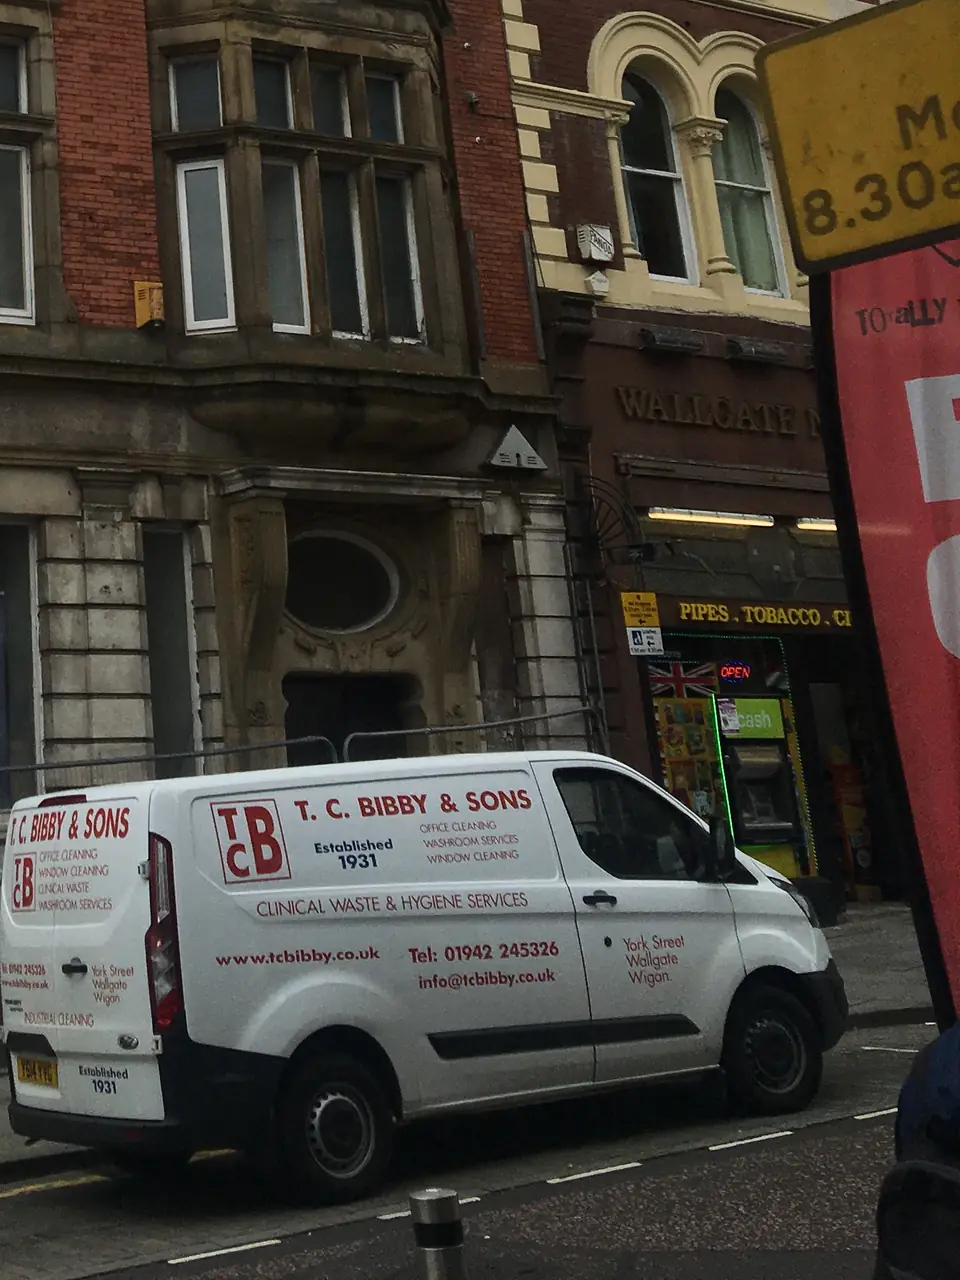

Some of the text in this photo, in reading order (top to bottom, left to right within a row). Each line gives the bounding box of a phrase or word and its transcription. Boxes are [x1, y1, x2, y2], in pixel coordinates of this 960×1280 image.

[617, 385, 798, 436] WALLGATE
[680, 603, 729, 622] PIPES
[743, 606, 821, 626] TOBACCO
[721, 666, 751, 679] OPEN
[738, 709, 772, 728] cash
[358, 794, 427, 818] BIBBY
[440, 793, 459, 813] &
[466, 789, 532, 812] SONS
[30, 811, 67, 843] BIBBY
[68, 810, 79, 840] &
[83, 807, 130, 839] SONS
[419, 820, 497, 834] OFFICE CLEANING
[314, 838, 394, 854] Established
[423, 834, 519, 849] WASHROOM SERVICES
[61, 848, 98, 861] CLEANING
[338, 853, 378, 870] 1931
[427, 849, 520, 865] WINDOW CLEANING
[70, 865, 109, 877] CLEANING
[66, 882, 90, 894] WASTE
[79, 898, 113, 910] SERVICES
[256, 892, 529, 917] CLINICAL WASTE & HYGIENE SERVICES
[623, 934, 685, 952] York Street
[215, 945, 381, 967] www.tcbibby.co.uk
[408, 941, 560, 963] Tel: 01942 245326
[625, 952, 680, 970] Wallgate
[92, 965, 134, 977] York Street
[418, 968, 556, 990] info@tcbibby.co.uk
[92, 978, 127, 993] Wallgate
[59, 1013, 94, 1028] CLEANING
[78, 1065, 129, 1079] Established
[92, 1080, 117, 1094] 1931
